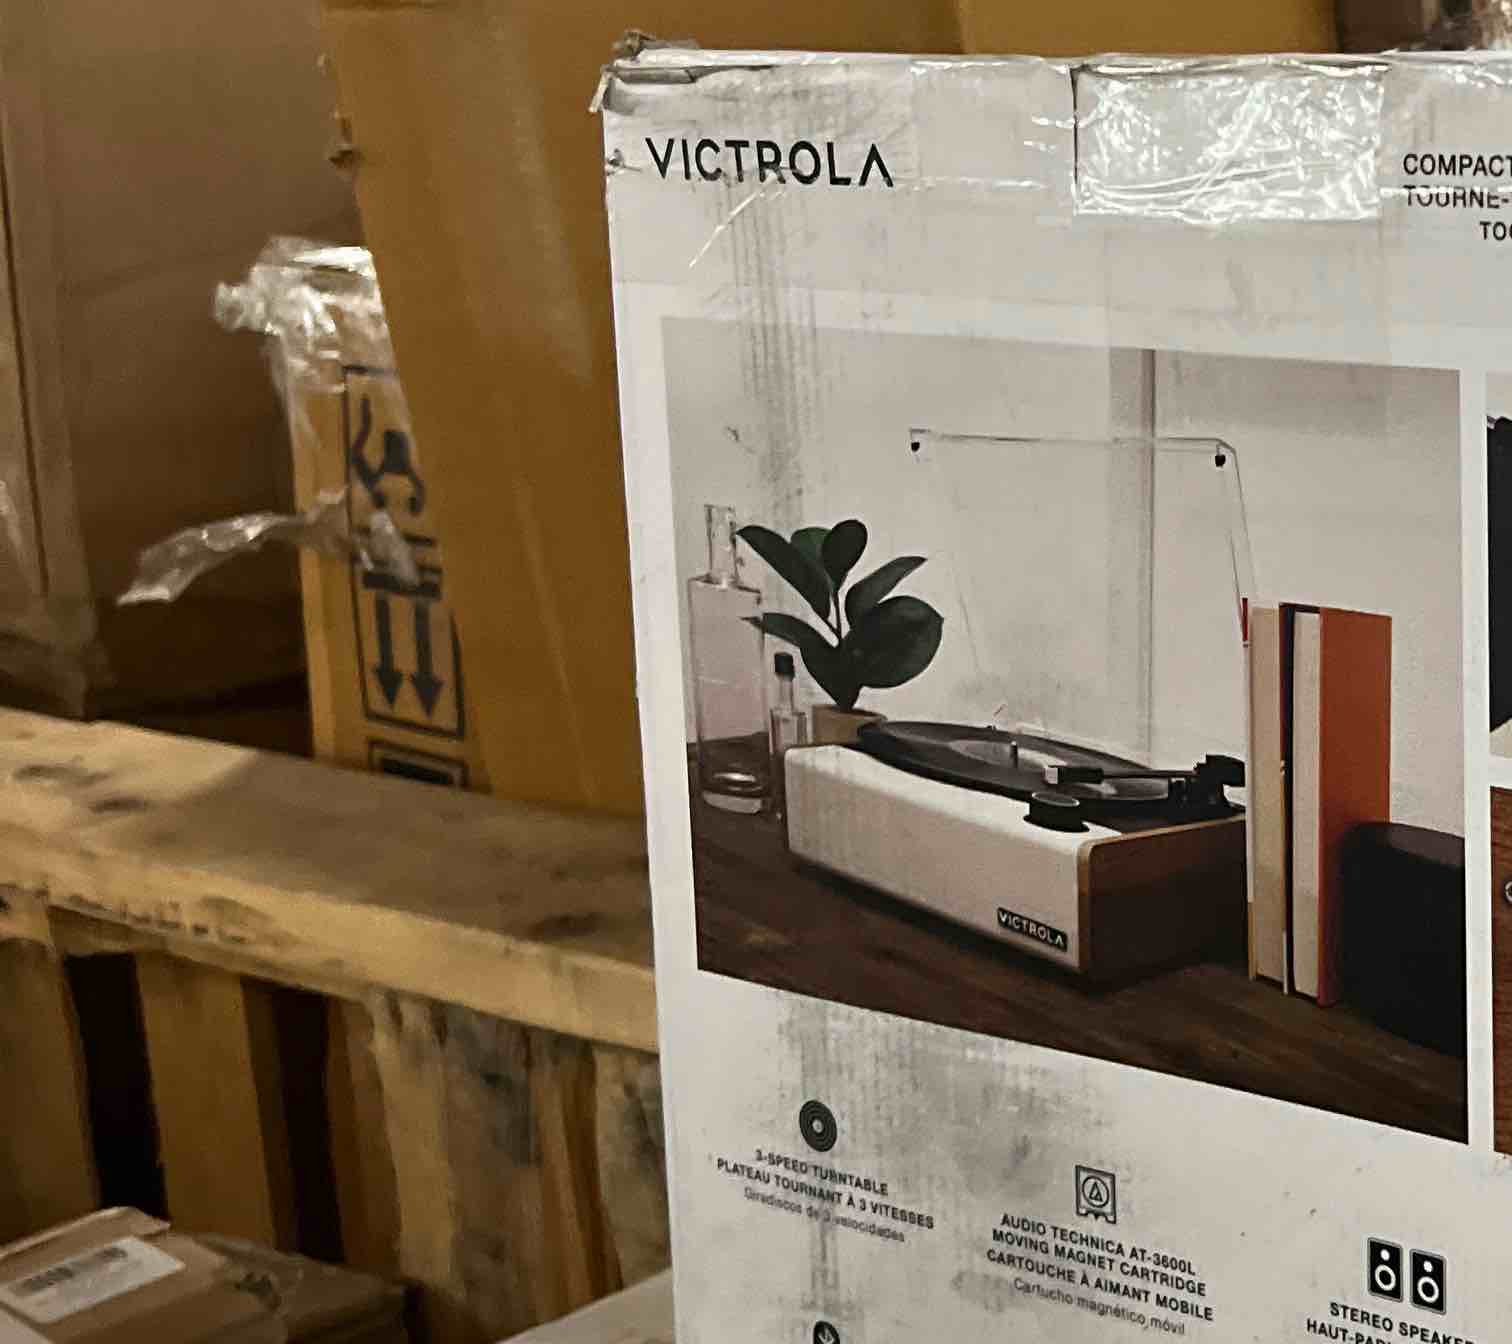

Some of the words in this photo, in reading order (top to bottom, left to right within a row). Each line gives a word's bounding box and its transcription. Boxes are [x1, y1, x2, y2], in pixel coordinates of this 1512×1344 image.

[645, 137, 894, 187] VICTROLA
[999, 909, 1065, 949] VICTROLA
[717, 1158, 770, 1184] PLATEAU
[774, 1175, 843, 1205] TOURNANT
[871, 1203, 934, 1229] VITESSES
[813, 1165, 888, 1195] TURNTABLE
[1001, 1214, 1046, 1234] AUDIO
[1051, 1227, 1124, 1256] TECHNICA
[993, 1229, 1049, 1254] MOVING
[1054, 1244, 1115, 1271] MAGNET
[1120, 1262, 1206, 1296] CARTRIDGE
[987, 1249, 1075, 1284] CARTOUCHE
[1080, 1268, 1090, 1286] À
[1094, 1278, 1151, 1303] AIMANT
[1155, 1294, 1214, 1320] MOBILE
[1014, 1278, 1073, 1305] Cartucho
[1329, 1302, 1394, 1332] STEREO
